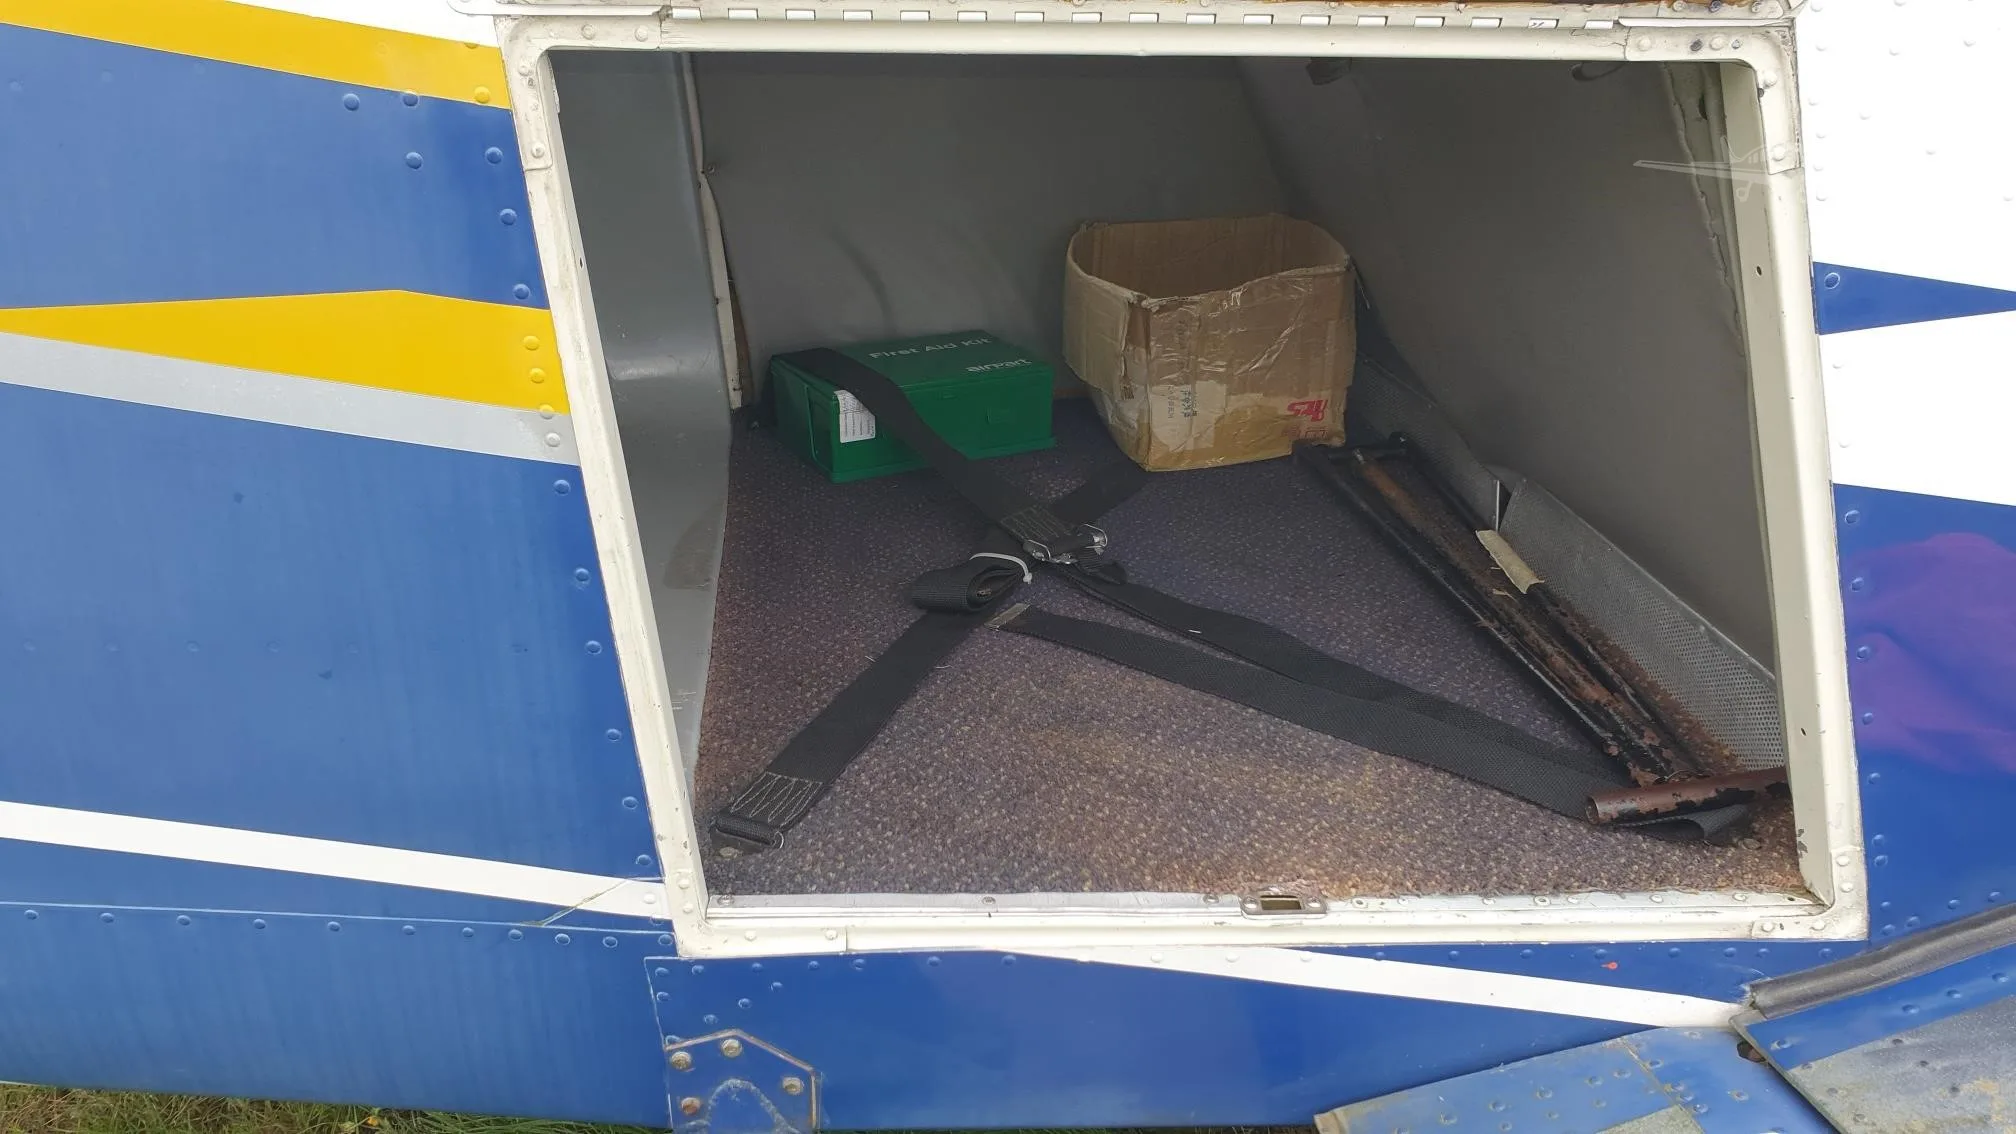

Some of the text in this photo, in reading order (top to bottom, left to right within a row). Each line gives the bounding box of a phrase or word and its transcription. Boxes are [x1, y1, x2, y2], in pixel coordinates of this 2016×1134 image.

[868, 337, 993, 359] First Aid Kit
